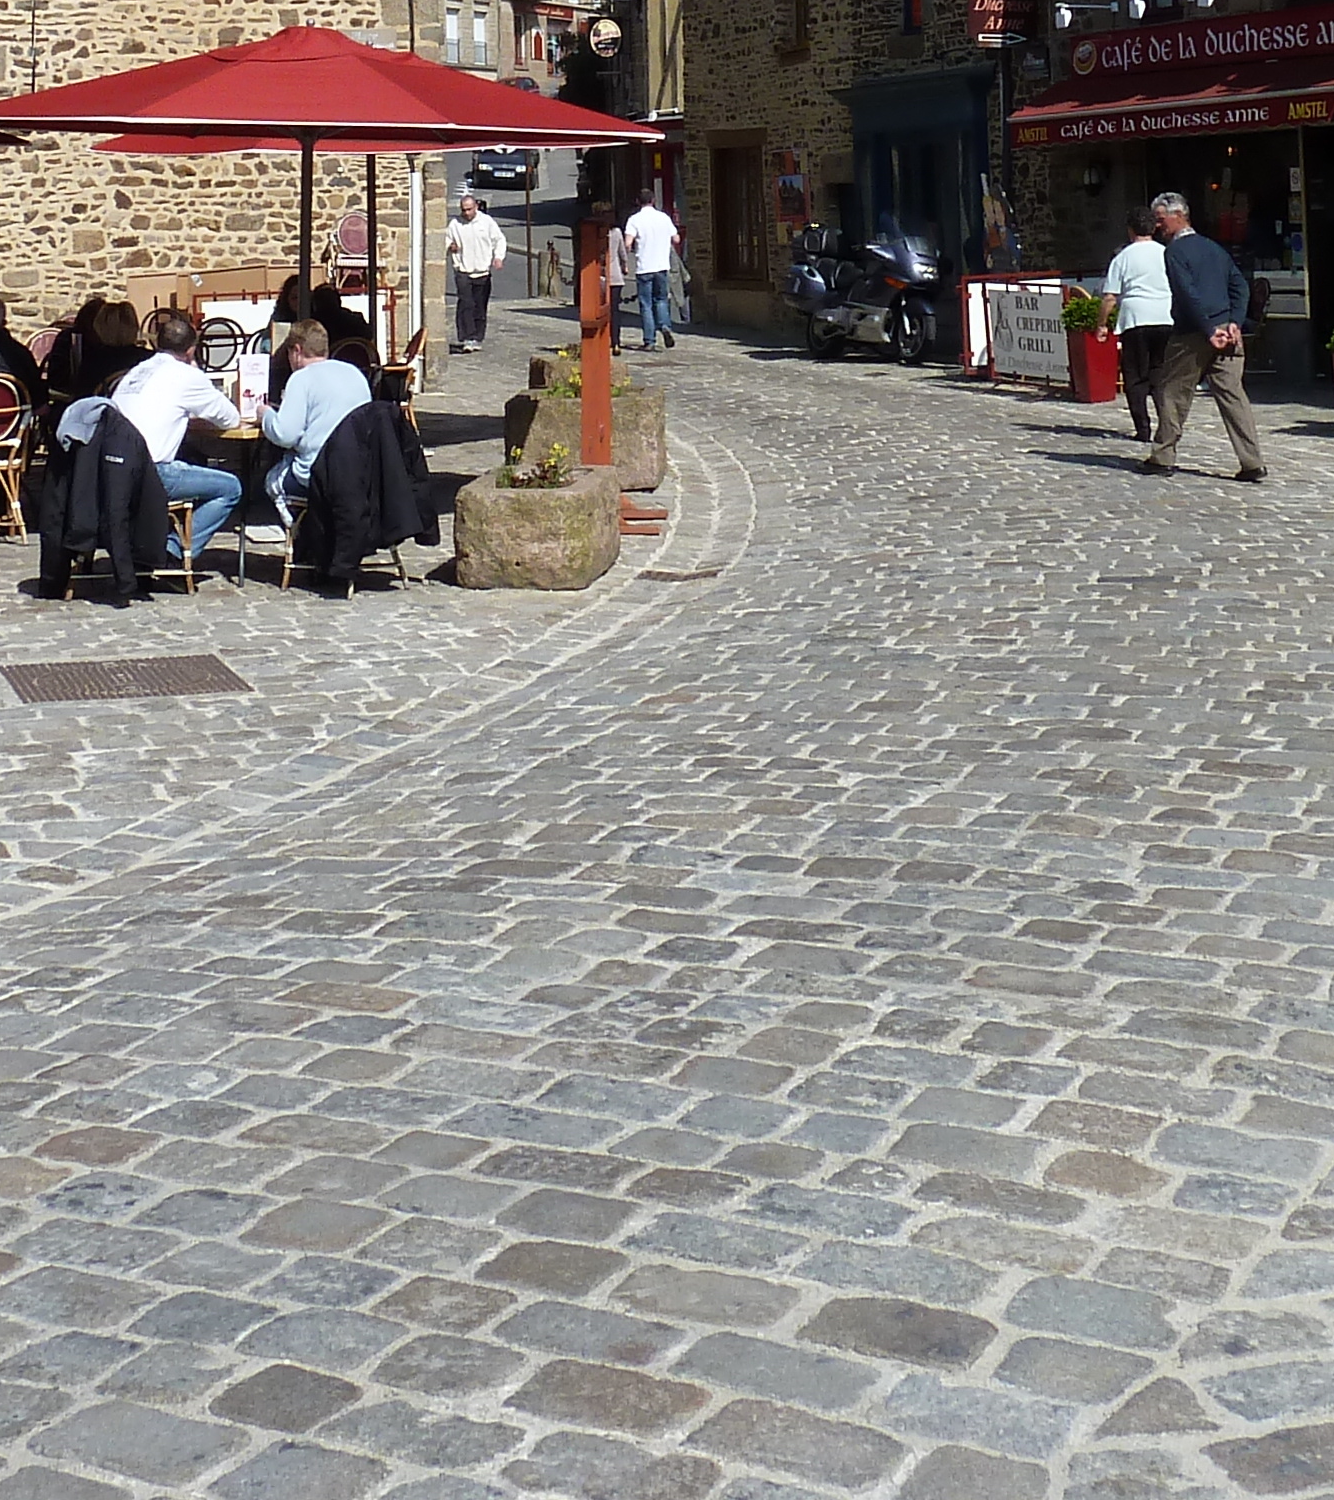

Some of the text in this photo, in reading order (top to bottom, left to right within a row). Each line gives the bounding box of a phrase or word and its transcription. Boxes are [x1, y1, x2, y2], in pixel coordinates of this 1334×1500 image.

[1018, 126, 1049, 143] AMSTEL
[1287, 100, 1329, 120] AMSTEL
[1015, 295, 1039, 311] BAR
[1018, 336, 1055, 354] GRILL
